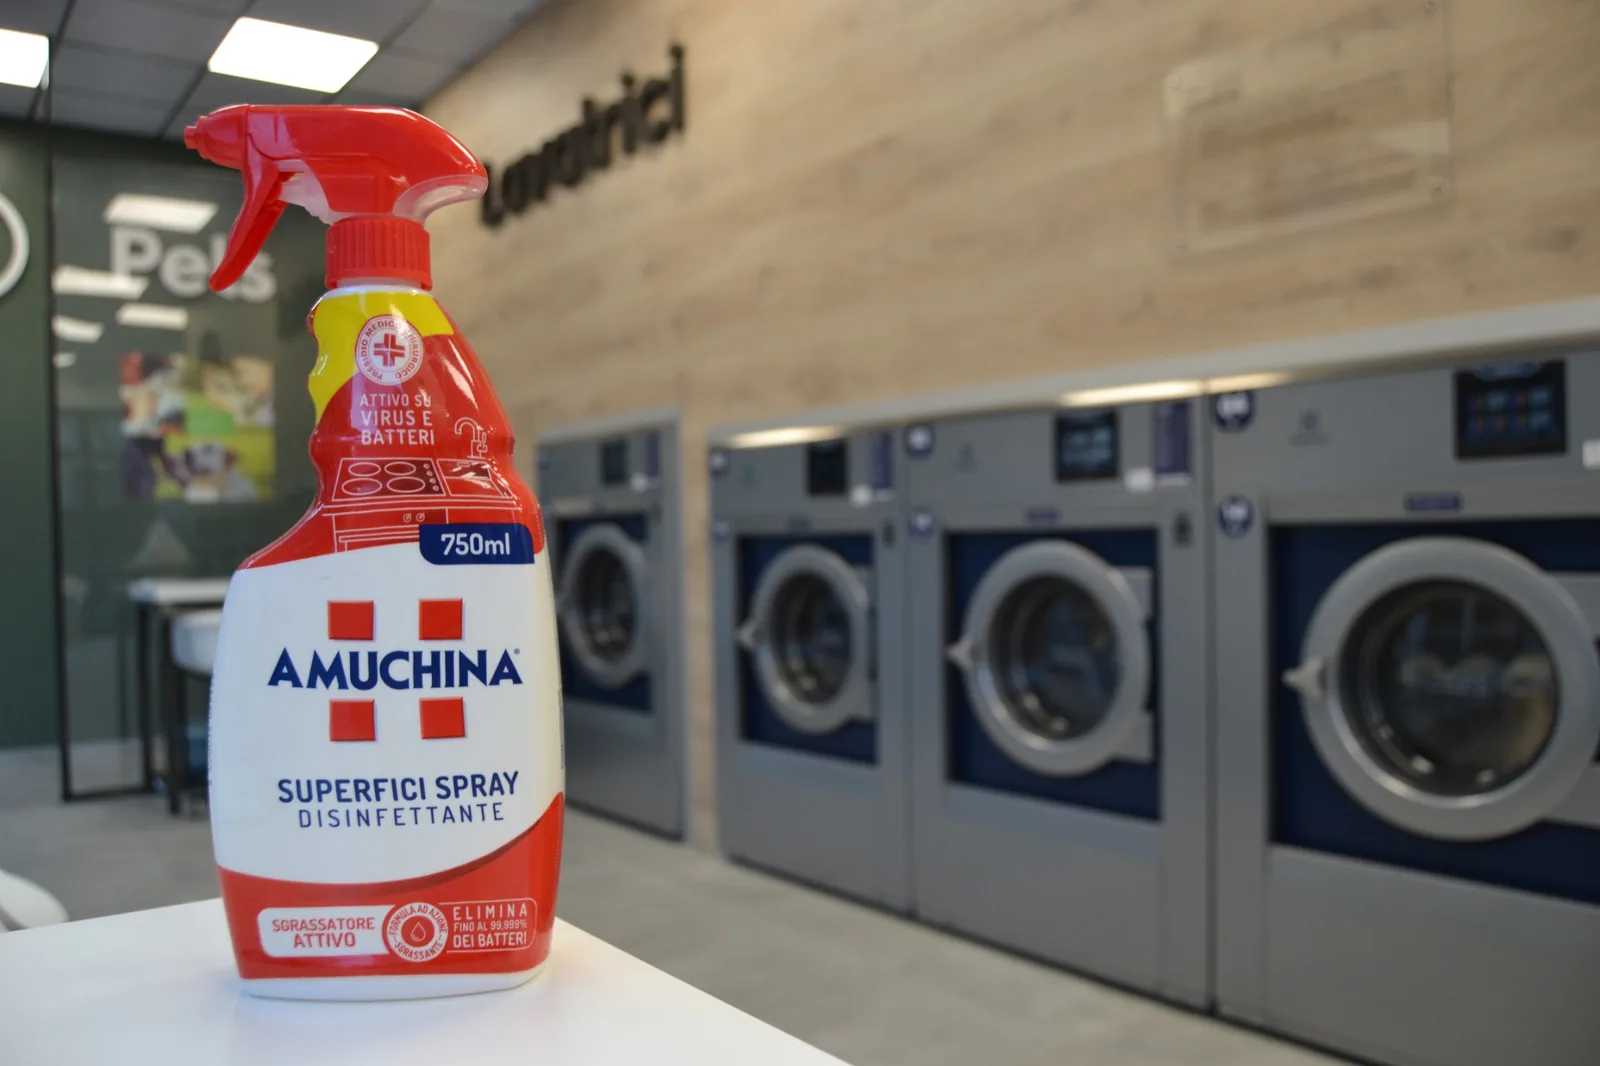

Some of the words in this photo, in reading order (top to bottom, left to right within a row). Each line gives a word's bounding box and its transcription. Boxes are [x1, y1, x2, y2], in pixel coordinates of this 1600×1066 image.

[360, 339, 383, 380] PRESIDIO
[360, 393, 410, 407] ATTIVO
[414, 394, 432, 408] SU
[360, 409, 416, 427] VIRUS
[422, 410, 433, 427] E
[361, 428, 435, 446] BATTERI
[440, 532, 511, 556] 750ml
[277, 776, 426, 804] SUPERFICI
[435, 770, 519, 800] SPRAY
[299, 801, 505, 828] DISINFETTANTE
[388, 905, 417, 936] FORMULA
[417, 904, 429, 914] AD
[429, 907, 448, 933] AZIONE
[452, 902, 528, 921] ELIMINA
[271, 916, 376, 933] SGRASSATORE
[453, 921, 475, 933] FINO
[477, 920, 489, 932] AL
[293, 931, 357, 949] ATTIVO
[452, 933, 475, 949] DEI
[477, 930, 528, 948] BATTERI
[394, 940, 444, 960] SGRASSANTE
